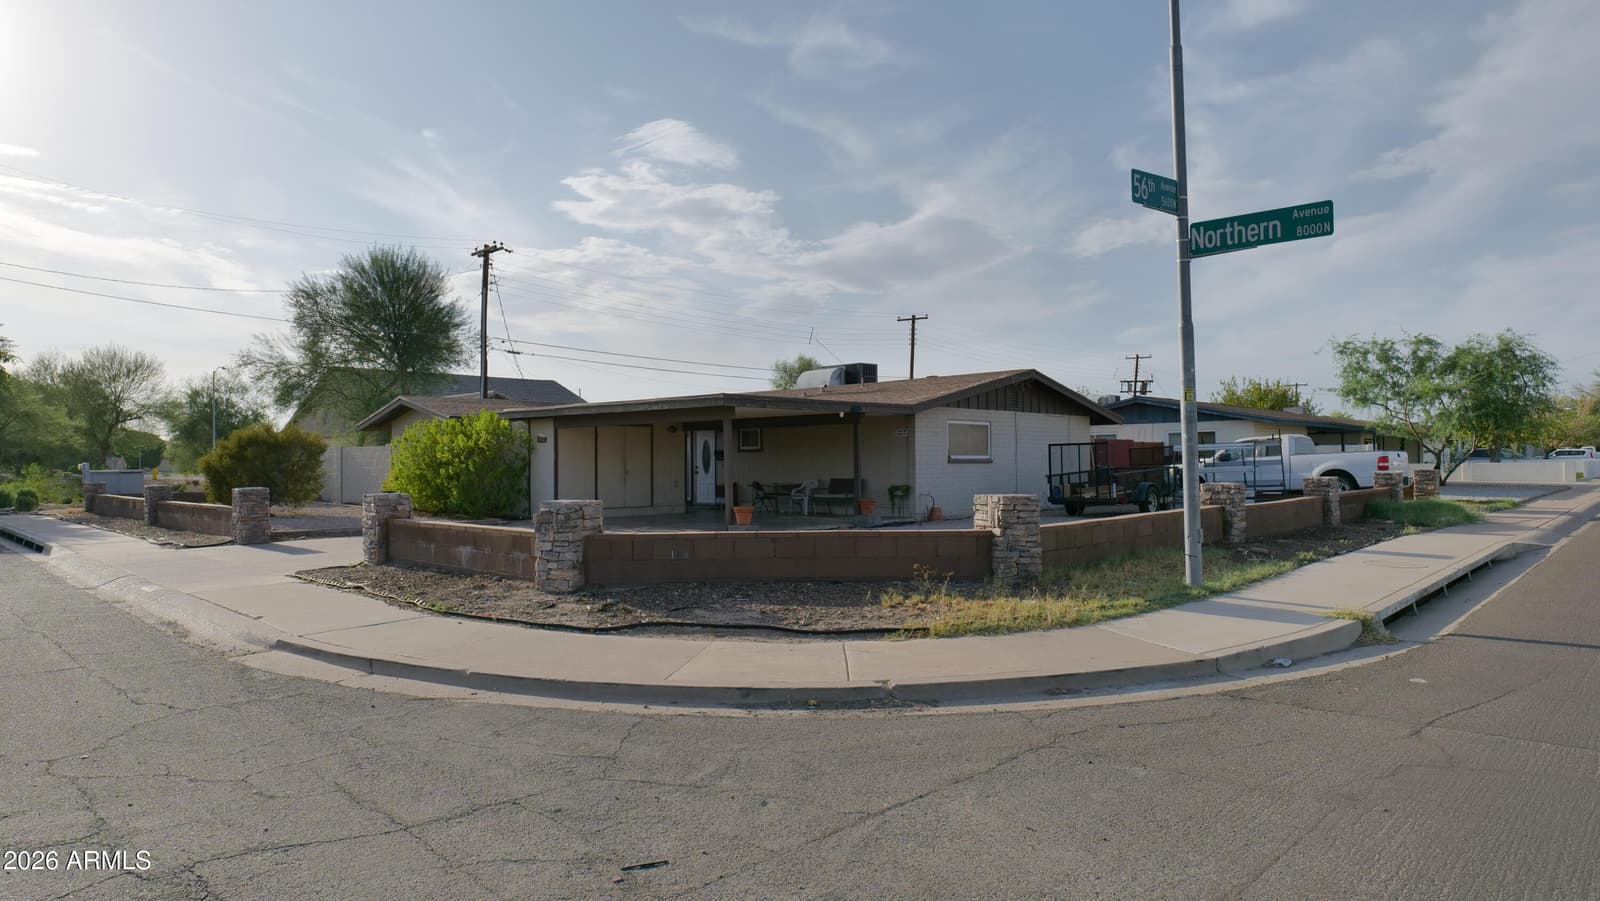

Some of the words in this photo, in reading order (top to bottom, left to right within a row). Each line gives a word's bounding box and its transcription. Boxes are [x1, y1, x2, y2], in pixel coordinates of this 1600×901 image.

[1133, 173, 1156, 200] 56th
[1292, 206, 1330, 220] Avenue
[1191, 220, 1282, 250] Northern
[1296, 221, 1332, 237] 8000N
